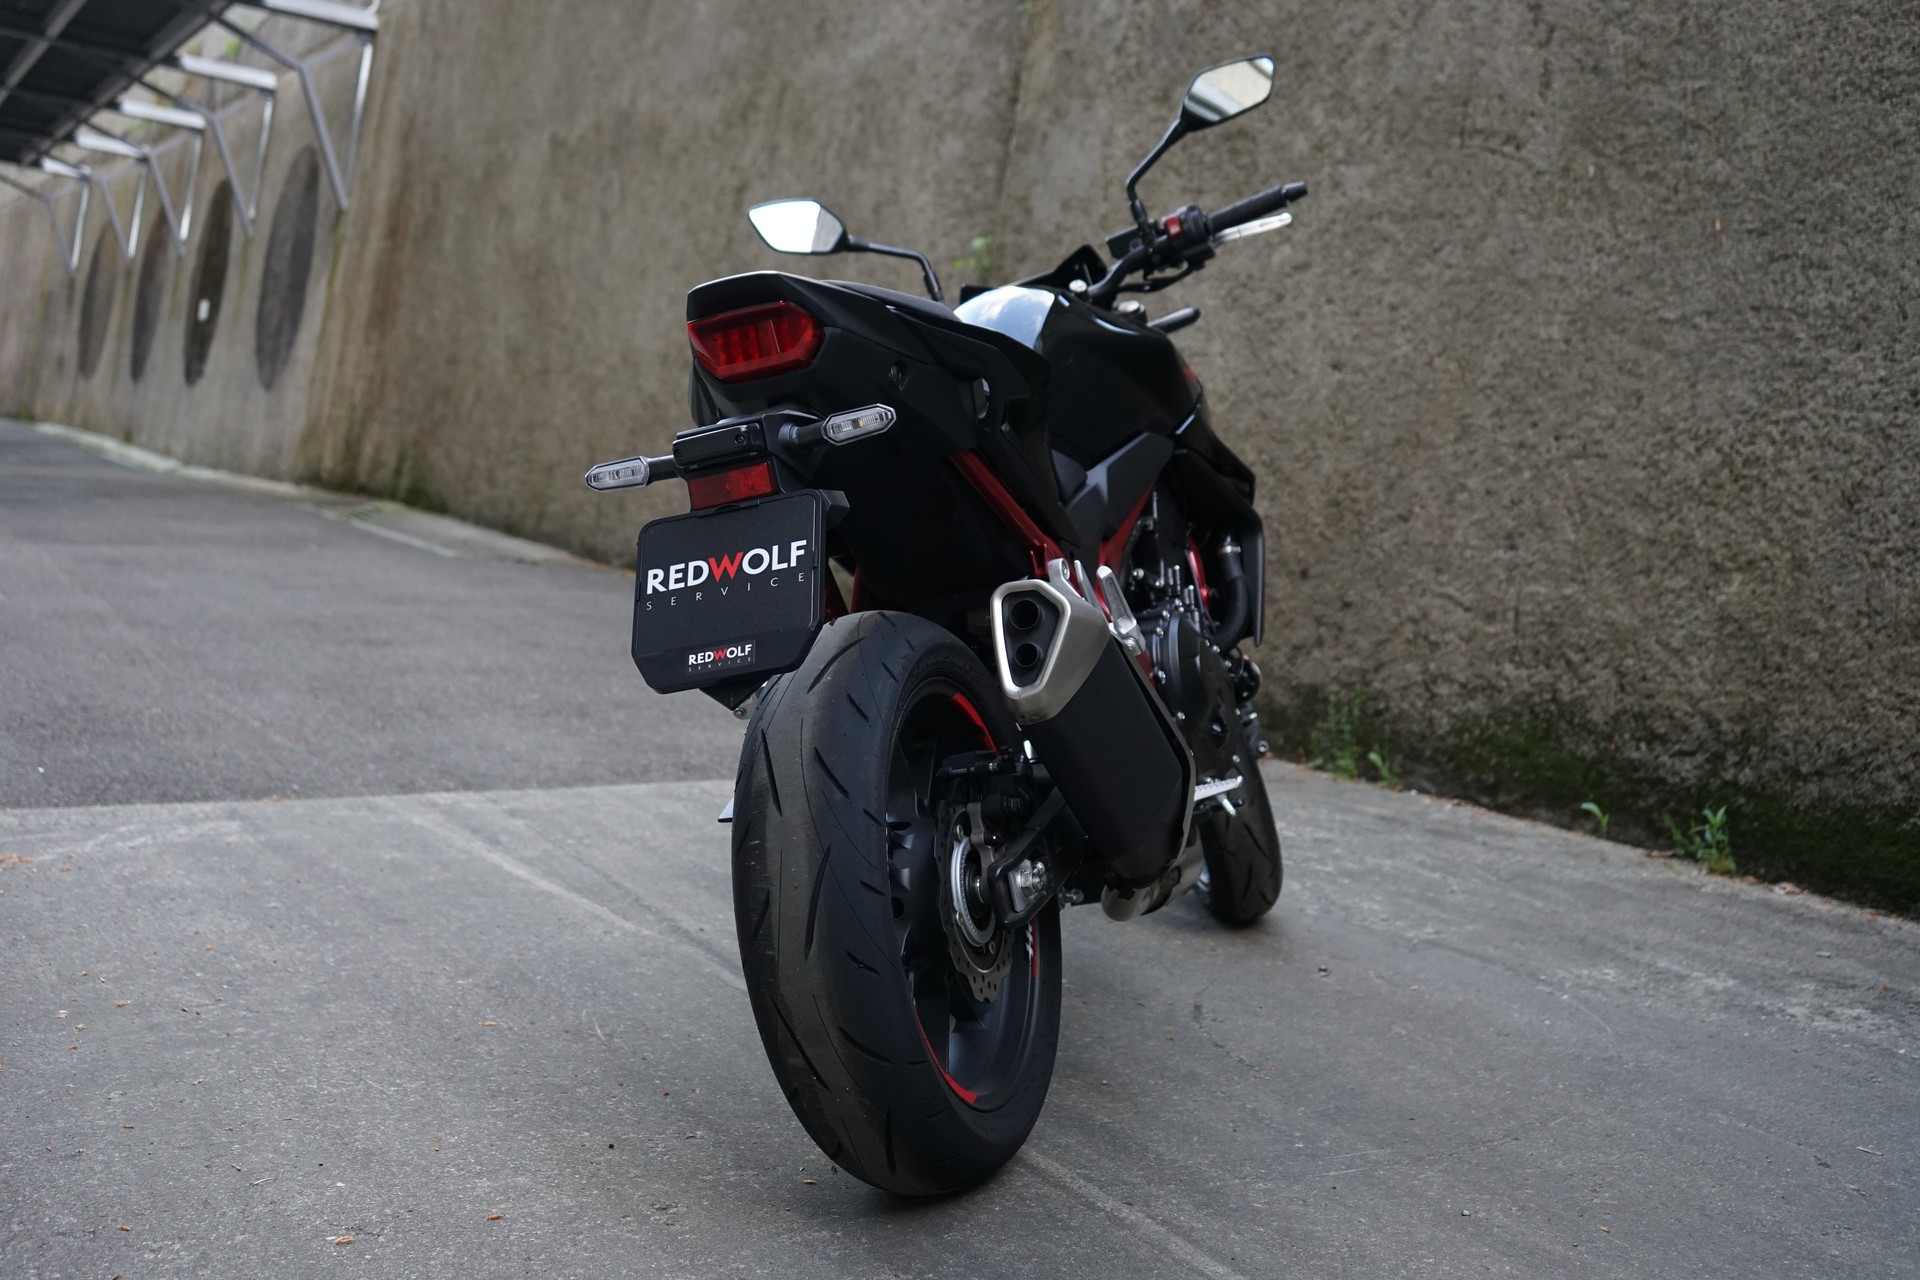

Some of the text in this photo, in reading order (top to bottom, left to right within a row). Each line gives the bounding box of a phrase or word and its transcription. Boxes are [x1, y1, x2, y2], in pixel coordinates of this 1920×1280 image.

[646, 539, 808, 595] REDWOLF
[646, 572, 805, 611] SERVICE
[688, 643, 753, 666] REDWOLF
